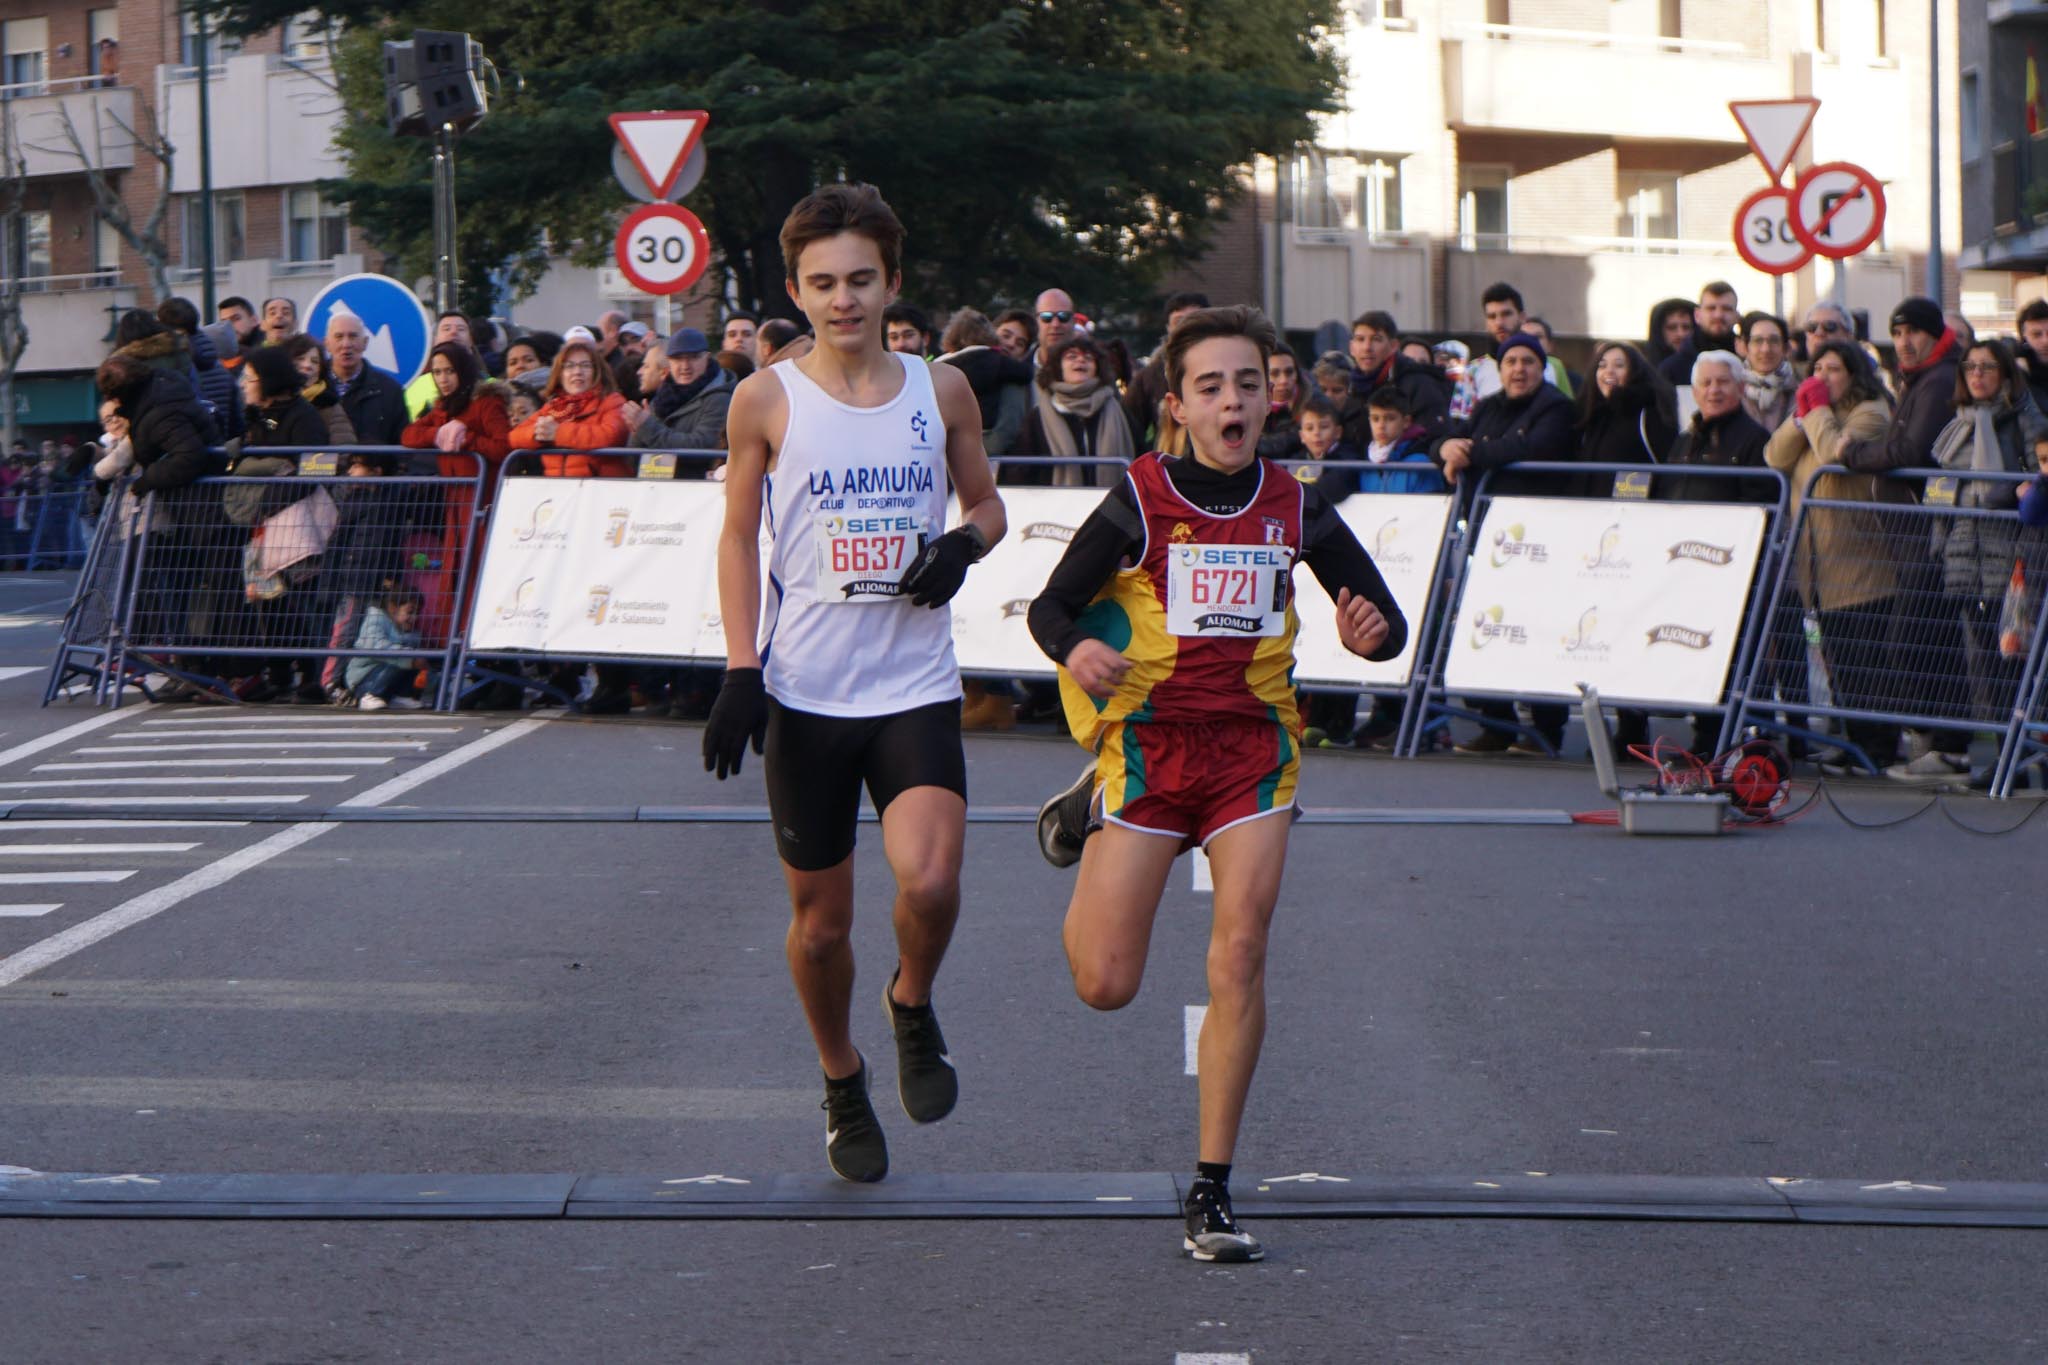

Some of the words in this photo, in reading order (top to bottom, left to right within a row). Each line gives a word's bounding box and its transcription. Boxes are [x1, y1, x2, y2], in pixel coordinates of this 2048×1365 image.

[637, 235, 685, 264] 30
[809, 470, 834, 495] LA
[842, 460, 933, 494] ARMUÑA
[820, 499, 844, 510] CLUB
[858, 497, 915, 509] DEPORTIVO
[847, 516, 919, 533] SETEL
[832, 535, 906, 572] 6637
[1203, 549, 1280, 566] SETEL
[1503, 542, 1549, 556] SETEL
[1678, 542, 1724, 563] ALJOMAR
[857, 571, 882, 579] DIEGO
[1191, 568, 1257, 605] 6721
[1207, 604, 1242, 613] MENDOZA
[1206, 615, 1254, 631] ALJOMAR
[1483, 624, 1528, 638] SETEL
[1657, 626, 1703, 647] ALJOMAR
